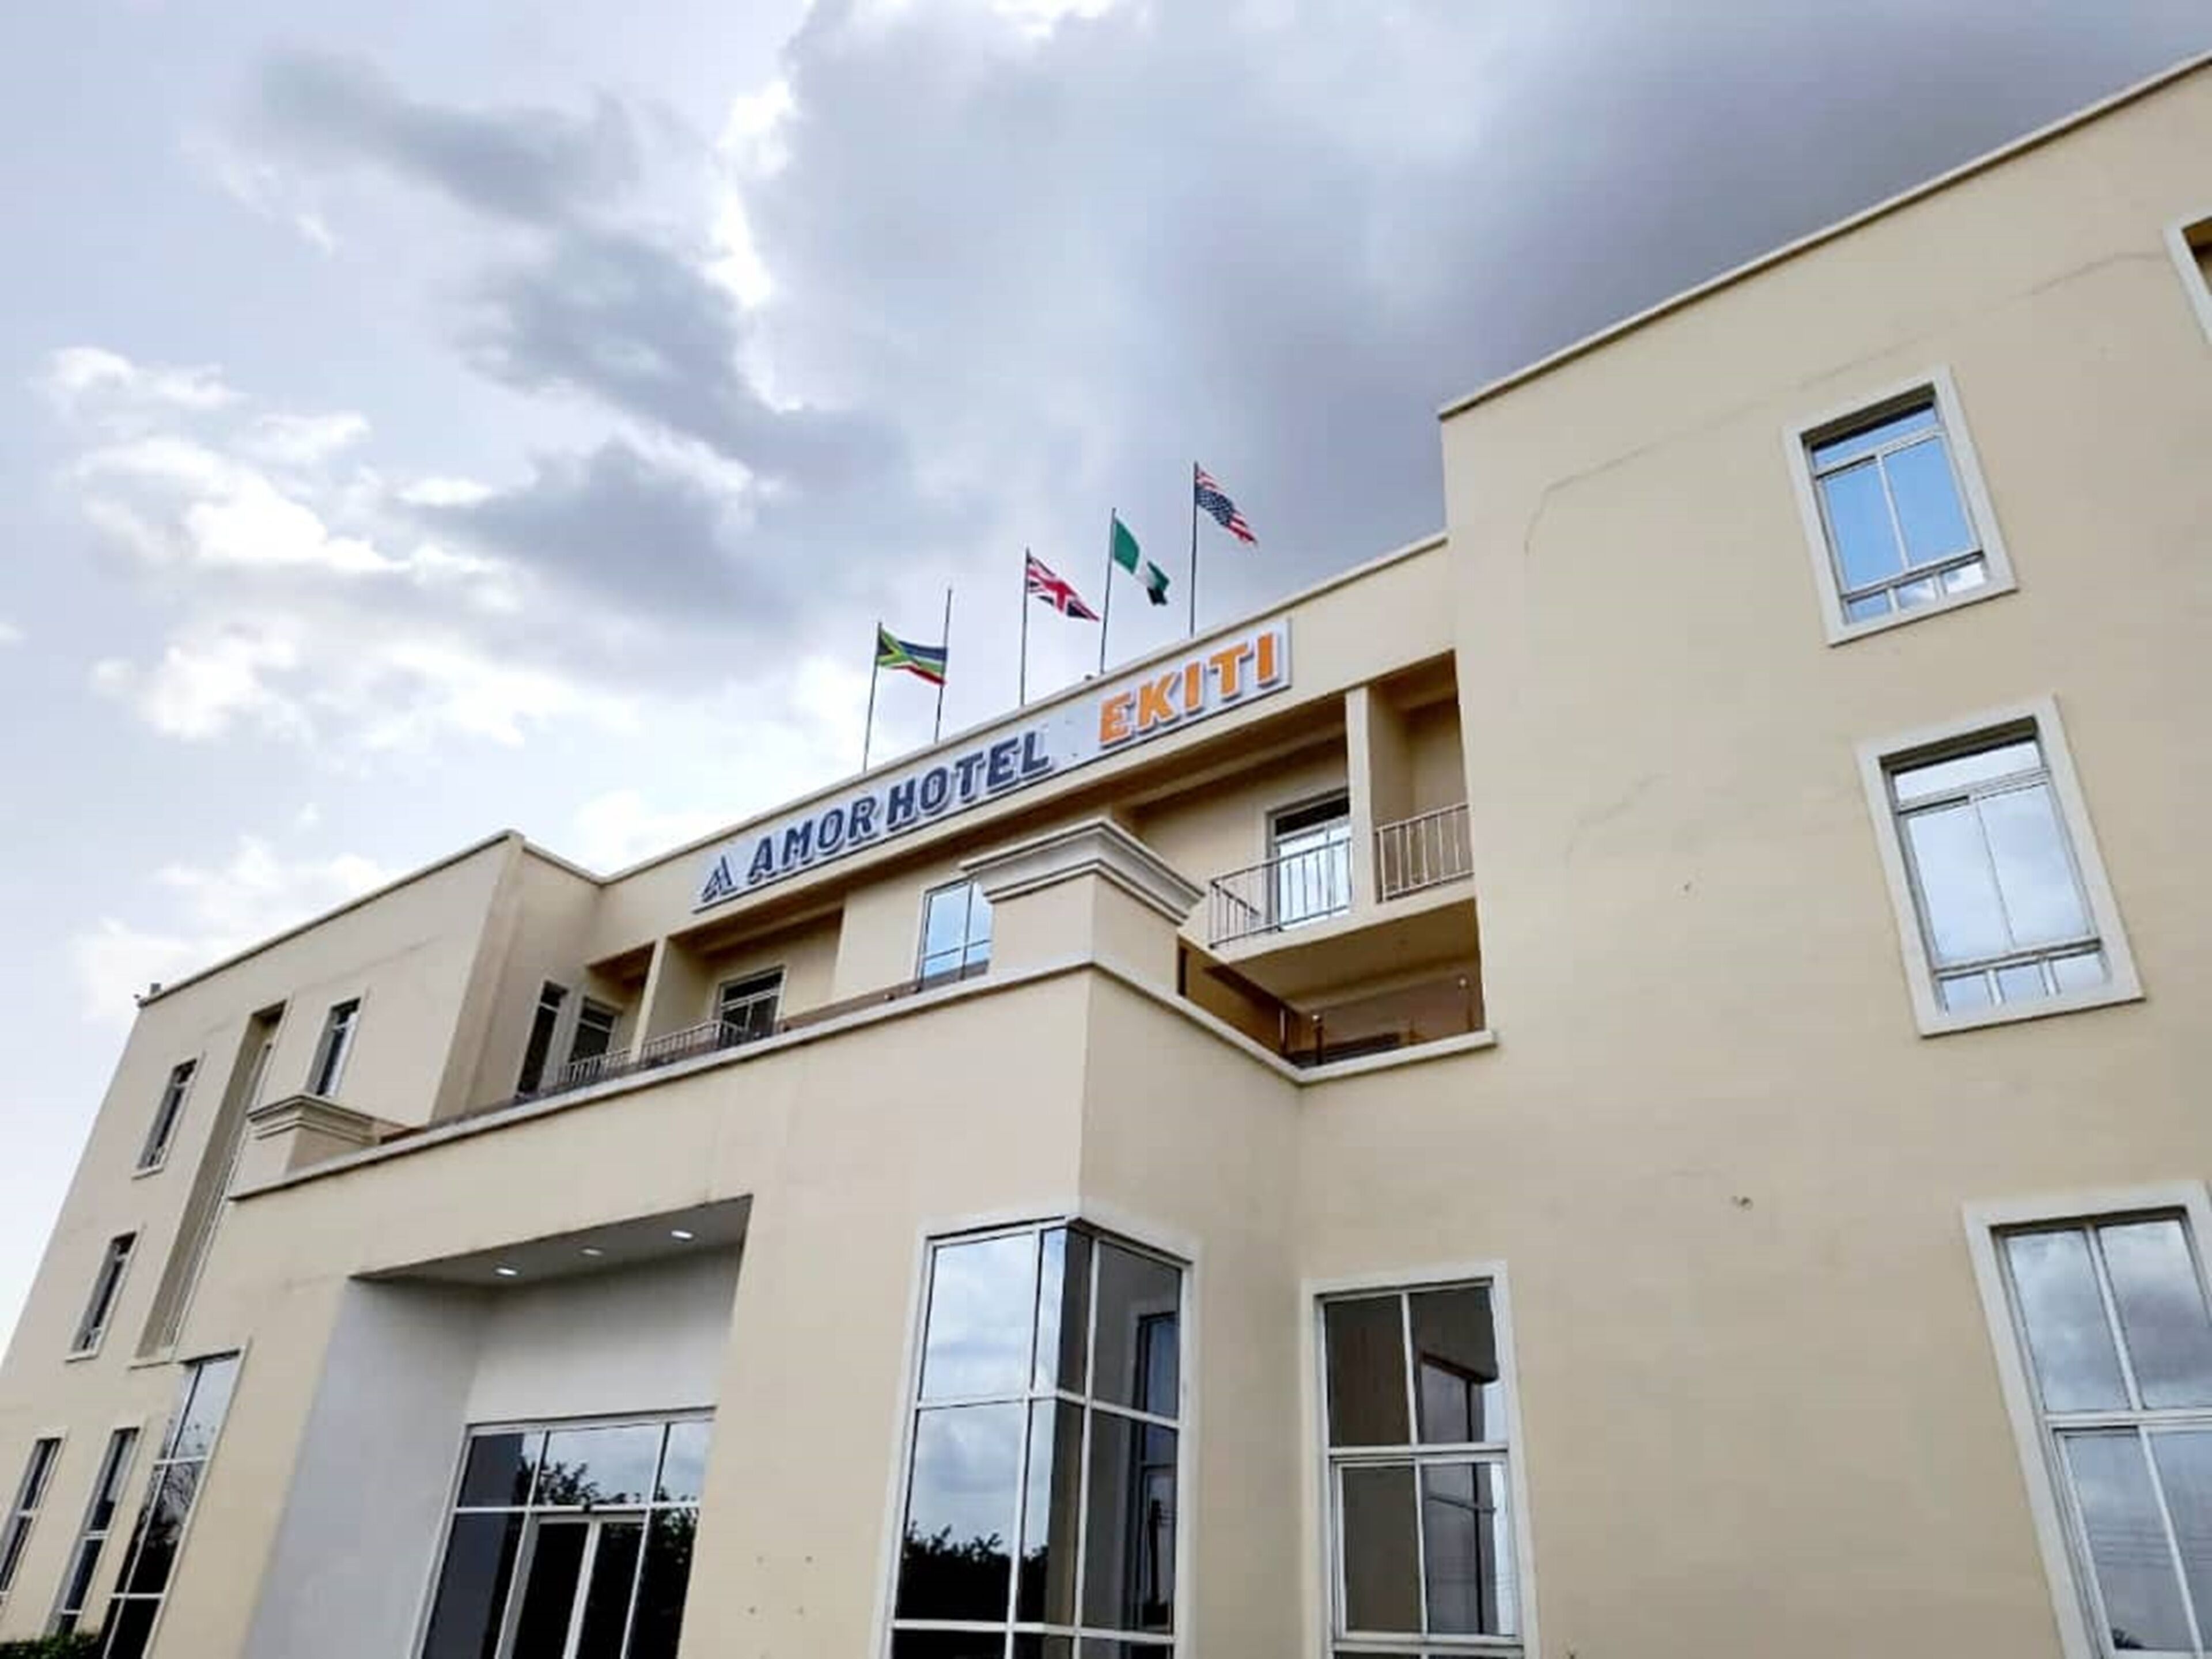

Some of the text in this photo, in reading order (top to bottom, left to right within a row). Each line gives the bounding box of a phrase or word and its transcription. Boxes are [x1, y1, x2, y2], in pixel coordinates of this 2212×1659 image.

[748, 632, 1274, 880] AMOR HOTEL EKITI
